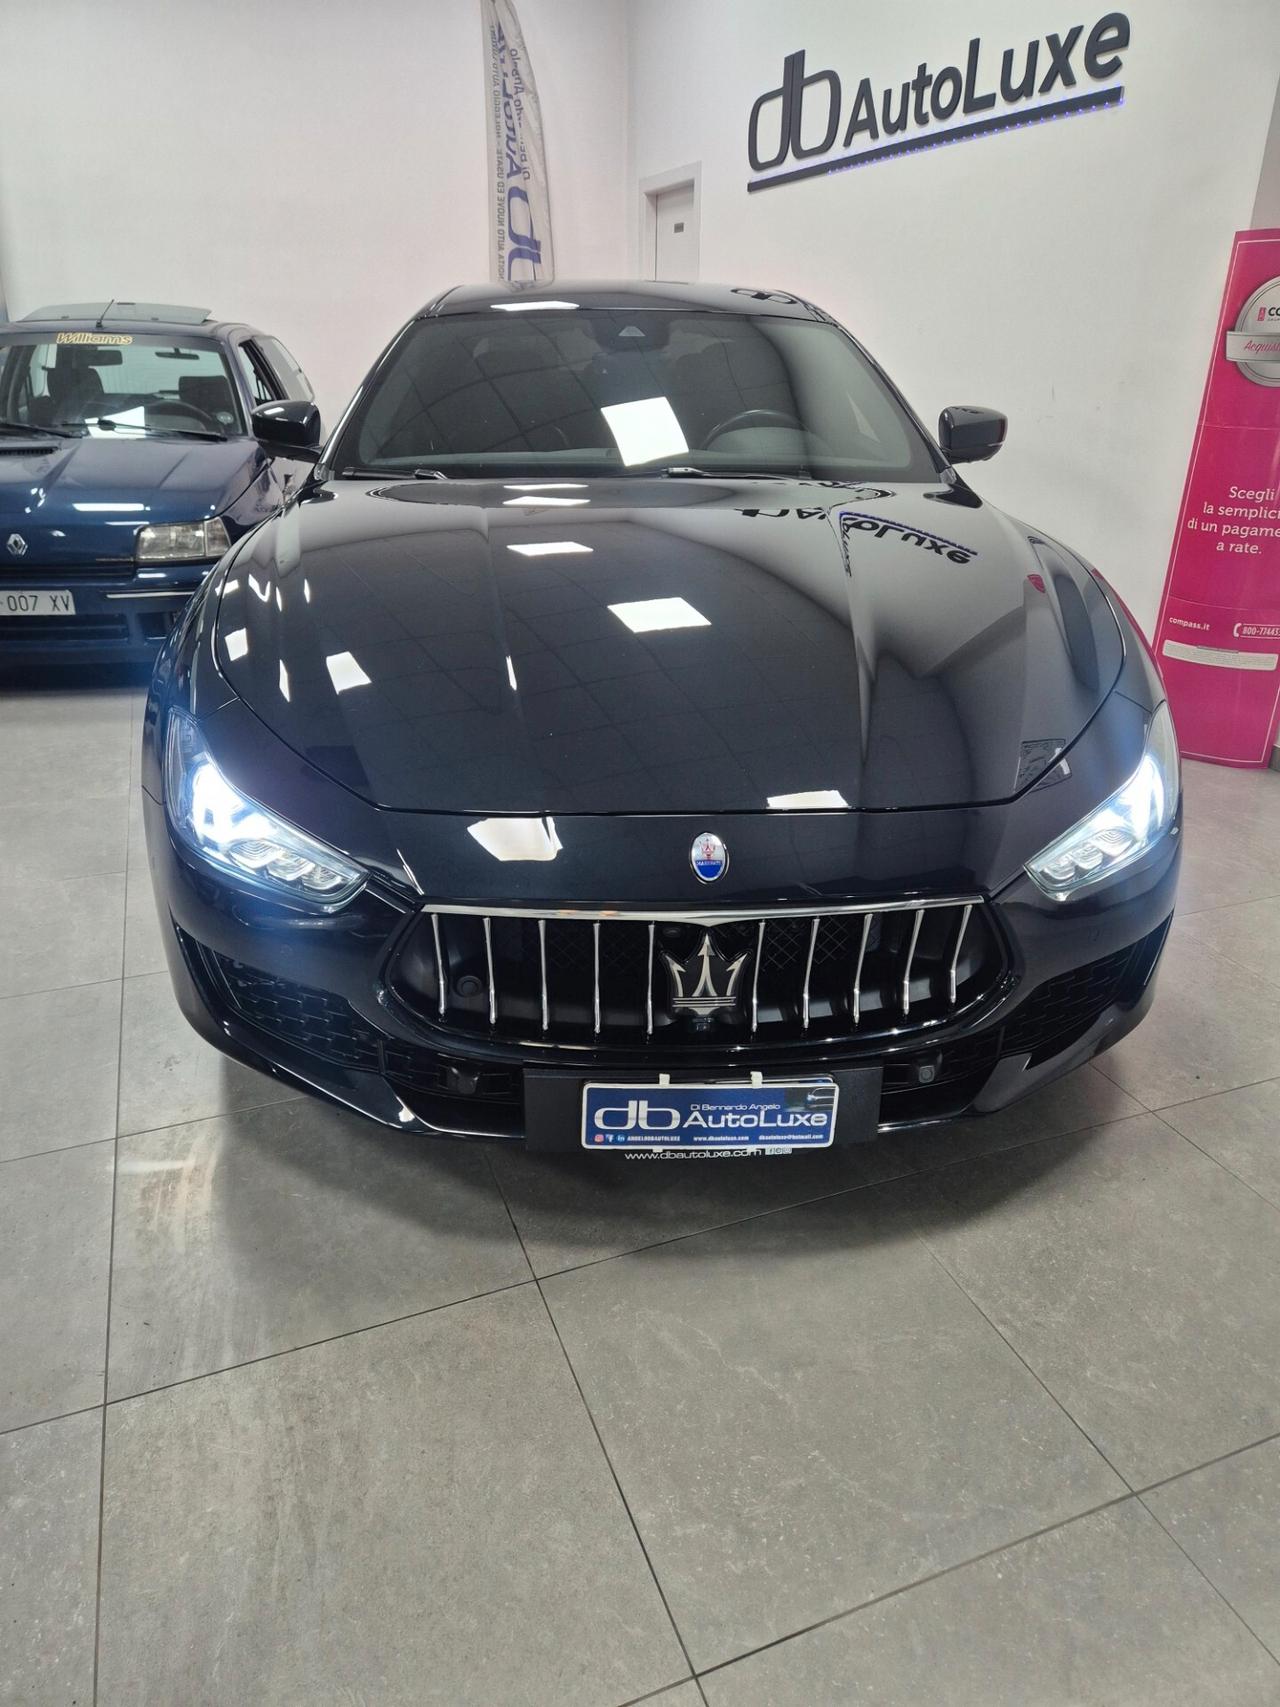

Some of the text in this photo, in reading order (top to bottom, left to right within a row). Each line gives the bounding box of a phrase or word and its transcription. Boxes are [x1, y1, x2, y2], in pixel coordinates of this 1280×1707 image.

[843, 12, 1131, 147] AutoLuxe
[56, 332, 133, 345] Williams
[1229, 486, 1275, 503] Scegli
[1203, 501, 1214, 514] la
[1187, 517, 1198, 530] di
[1201, 522, 1218, 533] un
[1216, 541, 1262, 554] a rate.
[49, 594, 70, 612] XV
[1168, 617, 1210, 631] compass.it
[594, 1100, 828, 1130] db AutoLuxe
[748, 1103, 781, 1112] Angelo
